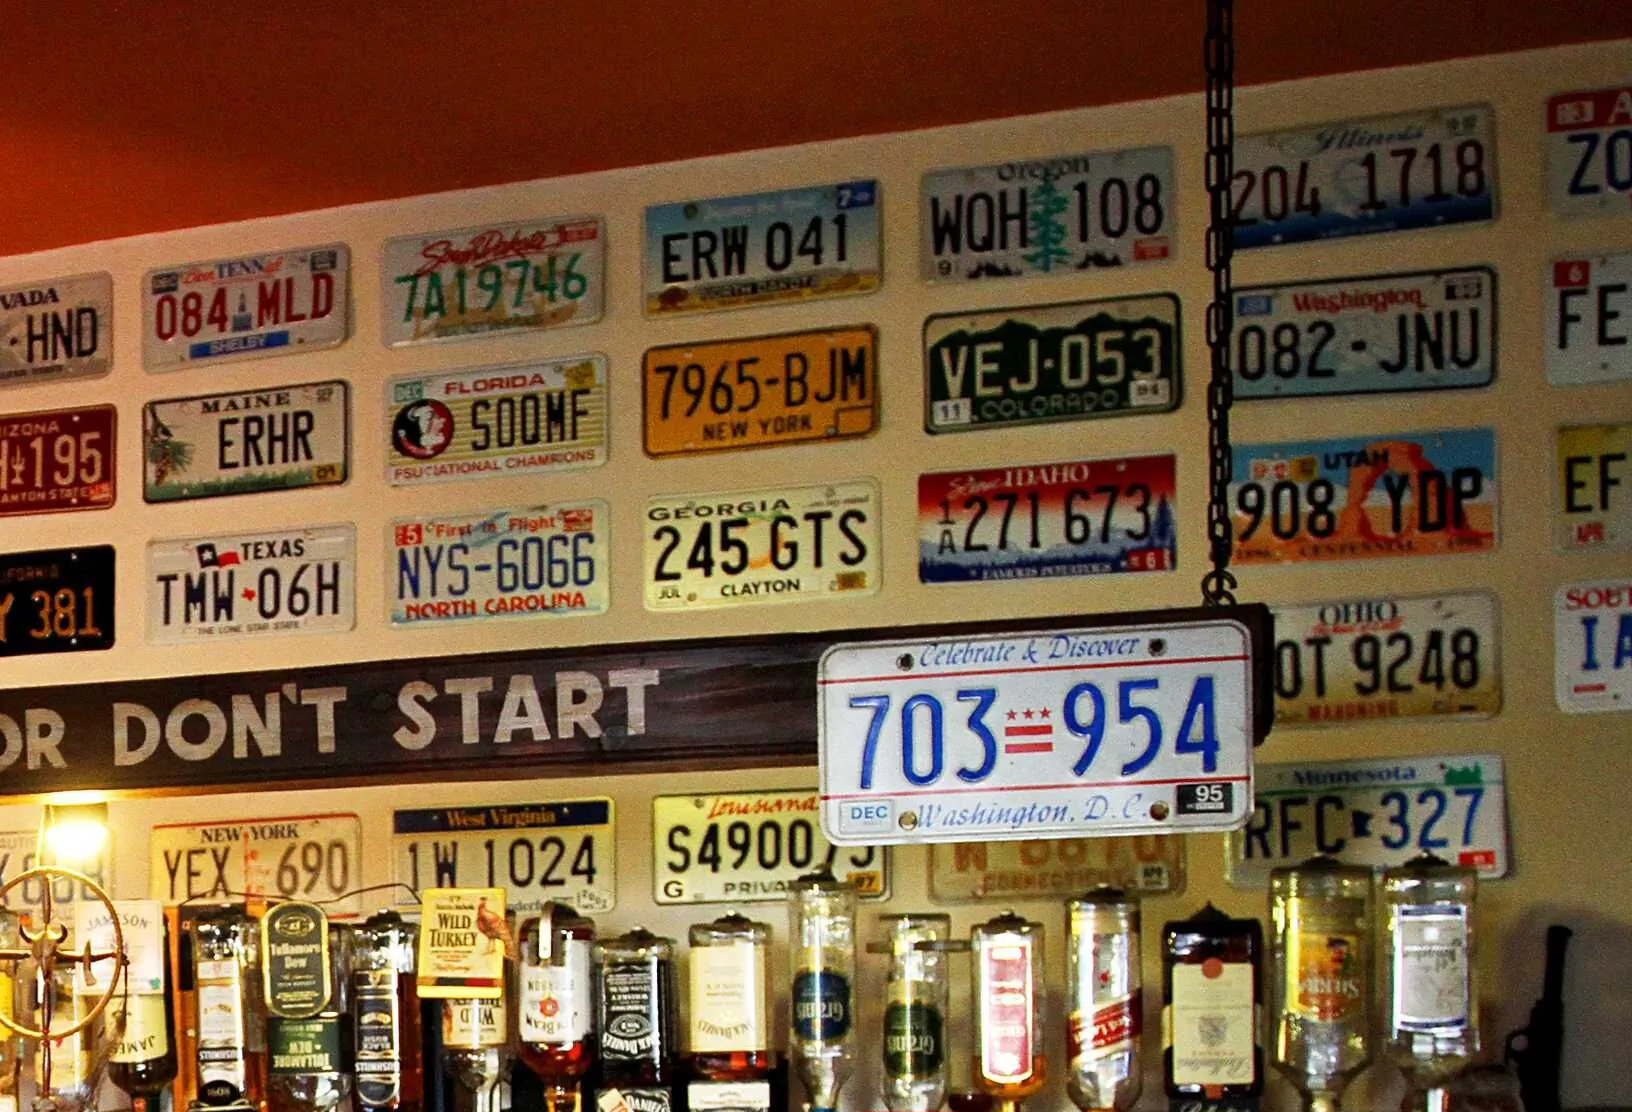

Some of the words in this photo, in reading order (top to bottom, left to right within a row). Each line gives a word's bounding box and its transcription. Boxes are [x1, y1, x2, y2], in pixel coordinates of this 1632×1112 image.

[998, 158, 1090, 183] Oregon
[1359, 139, 1485, 212] 1718
[930, 189, 1028, 256] WQH
[1072, 173, 1164, 242] 108
[662, 225, 749, 285] ERW
[765, 214, 848, 272] 041
[394, 252, 590, 323] 7A19746
[156, 287, 230, 341] 084
[257, 272, 334, 329] MLD
[210, 335, 268, 355] SHELBY
[444, 372, 546, 397] FLORIDA
[653, 346, 868, 421] 7965-BJM
[201, 391, 291, 416] MAINE
[977, 389, 1120, 422] COLORADO
[218, 409, 315, 471] ERHR
[703, 419, 749, 442] NEW
[759, 413, 813, 437] YORK
[31, 432, 103, 488] 195
[393, 467, 422, 482] FSU
[506, 449, 596, 474] CHAMPIONS
[1323, 448, 1389, 470] UTAH
[1005, 465, 1091, 488] IDAHO
[1566, 453, 1627, 514] EF
[647, 499, 791, 523] GEORGIA
[964, 491, 1043, 553] 271
[1064, 484, 1153, 546] 673
[1237, 480, 1334, 542] 908
[1383, 467, 1483, 534] YDP
[435, 520, 473, 539] First
[508, 515, 556, 533] Flight
[241, 538, 305, 562] TEXAS
[654, 518, 750, 582] 245
[770, 510, 867, 574] GTS
[397, 532, 596, 600] NYS-6066
[156, 570, 235, 626] TMW
[258, 562, 341, 620] 06H
[720, 578, 802, 598] CLAYTON
[30, 587, 103, 638] 381
[404, 600, 477, 620] NORTH
[483, 591, 586, 613] CAROLINA
[1319, 601, 1399, 626] OHIO
[919, 641, 1016, 667] Celebrate
[1024, 641, 1042, 663] &
[1045, 634, 1142, 663] Discover
[1353, 628, 1480, 697] 9248
[112, 682, 347, 767] DON'T
[392, 668, 661, 751] START
[848, 687, 998, 790] 703
[1063, 675, 1221, 778] 954
[1292, 765, 1416, 786] Minnesota
[1195, 785, 1224, 802] 95
[446, 809, 483, 828] West
[485, 806, 556, 829] Virginia
[850, 805, 889, 822] DEC
[1244, 795, 1345, 858] RFC
[1380, 787, 1484, 849] 327
[200, 827, 243, 845] NEW
[243, 822, 300, 841] YORK
[163, 846, 232, 896] YEX
[275, 841, 349, 897] 690
[483, 834, 597, 888] 1024
[664, 880, 684, 899] G
[437, 913, 472, 930] WILD
[429, 929, 478, 948] TURKEY
[272, 1053, 331, 1069] TULLAMORE
